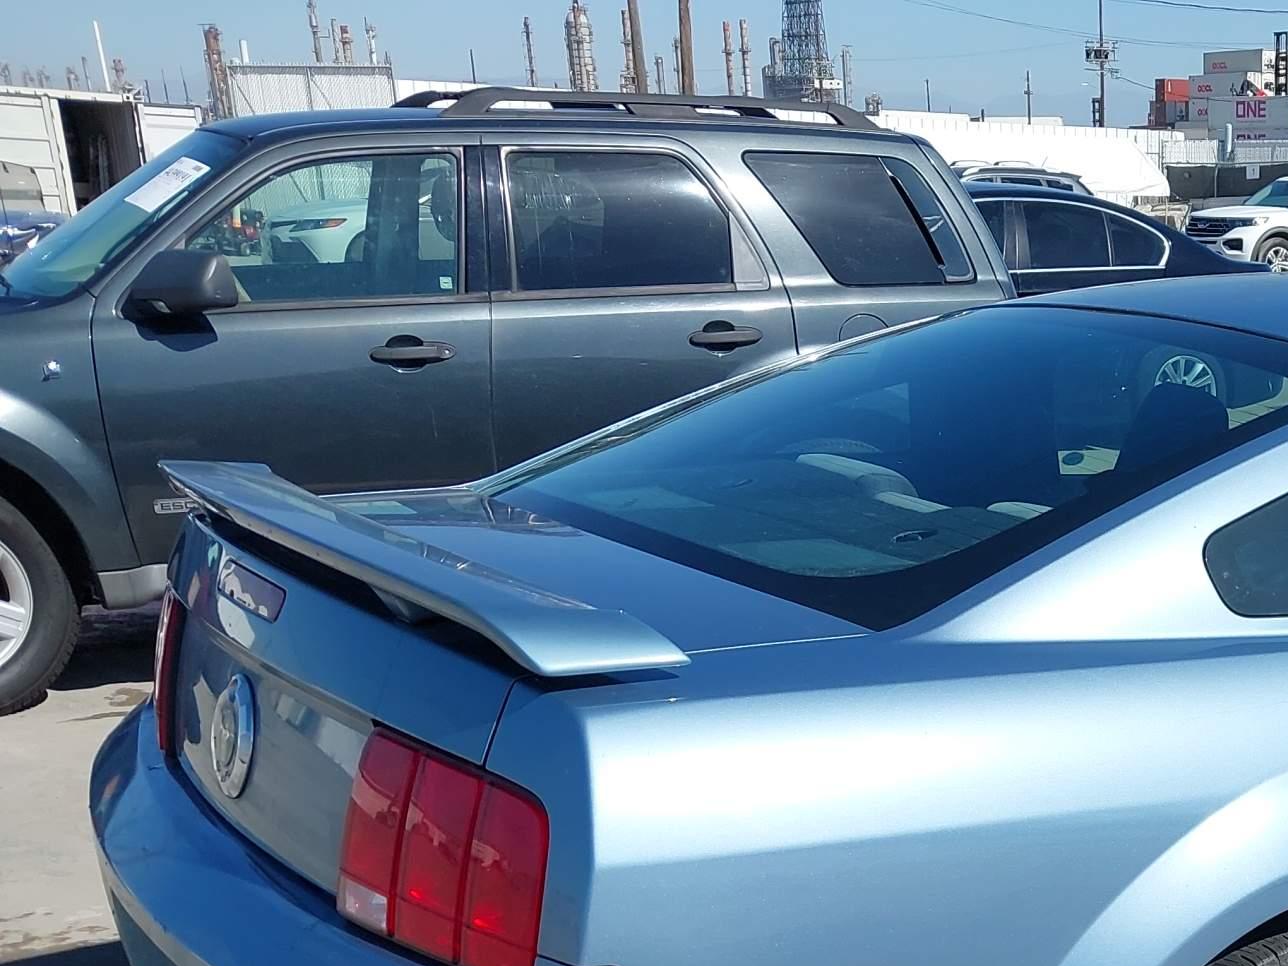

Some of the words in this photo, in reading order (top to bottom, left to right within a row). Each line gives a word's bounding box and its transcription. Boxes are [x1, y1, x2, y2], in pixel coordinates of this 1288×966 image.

[1197, 84, 1213, 93] OOCL
[1236, 100, 1267, 119] ONE
[1251, 167, 1256, 175] 1
